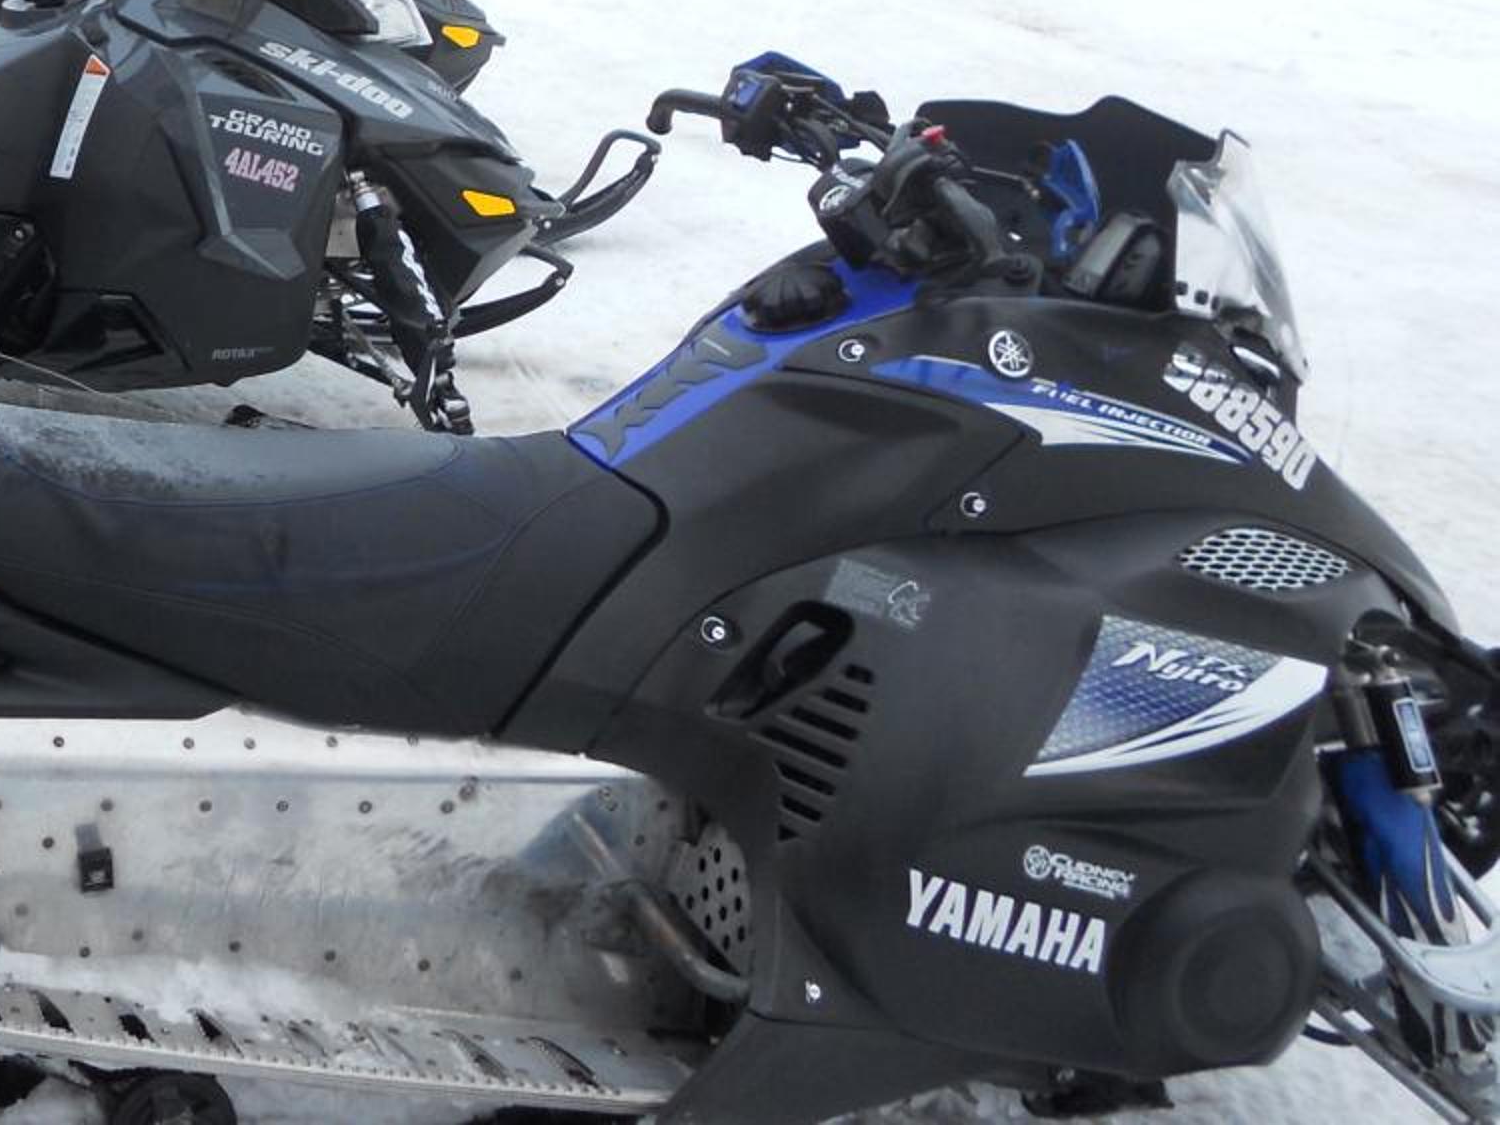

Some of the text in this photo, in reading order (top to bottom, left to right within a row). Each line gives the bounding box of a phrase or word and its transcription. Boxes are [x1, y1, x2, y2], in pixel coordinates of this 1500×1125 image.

[209, 114, 324, 156] TOURING
[228, 108, 312, 140] GRAND
[223, 146, 300, 193] 4AL452
[1031, 383, 1212, 447] FUEL INJECTION
[1110, 641, 1245, 692] Nytro
[906, 868, 1106, 975] YAMAHA
